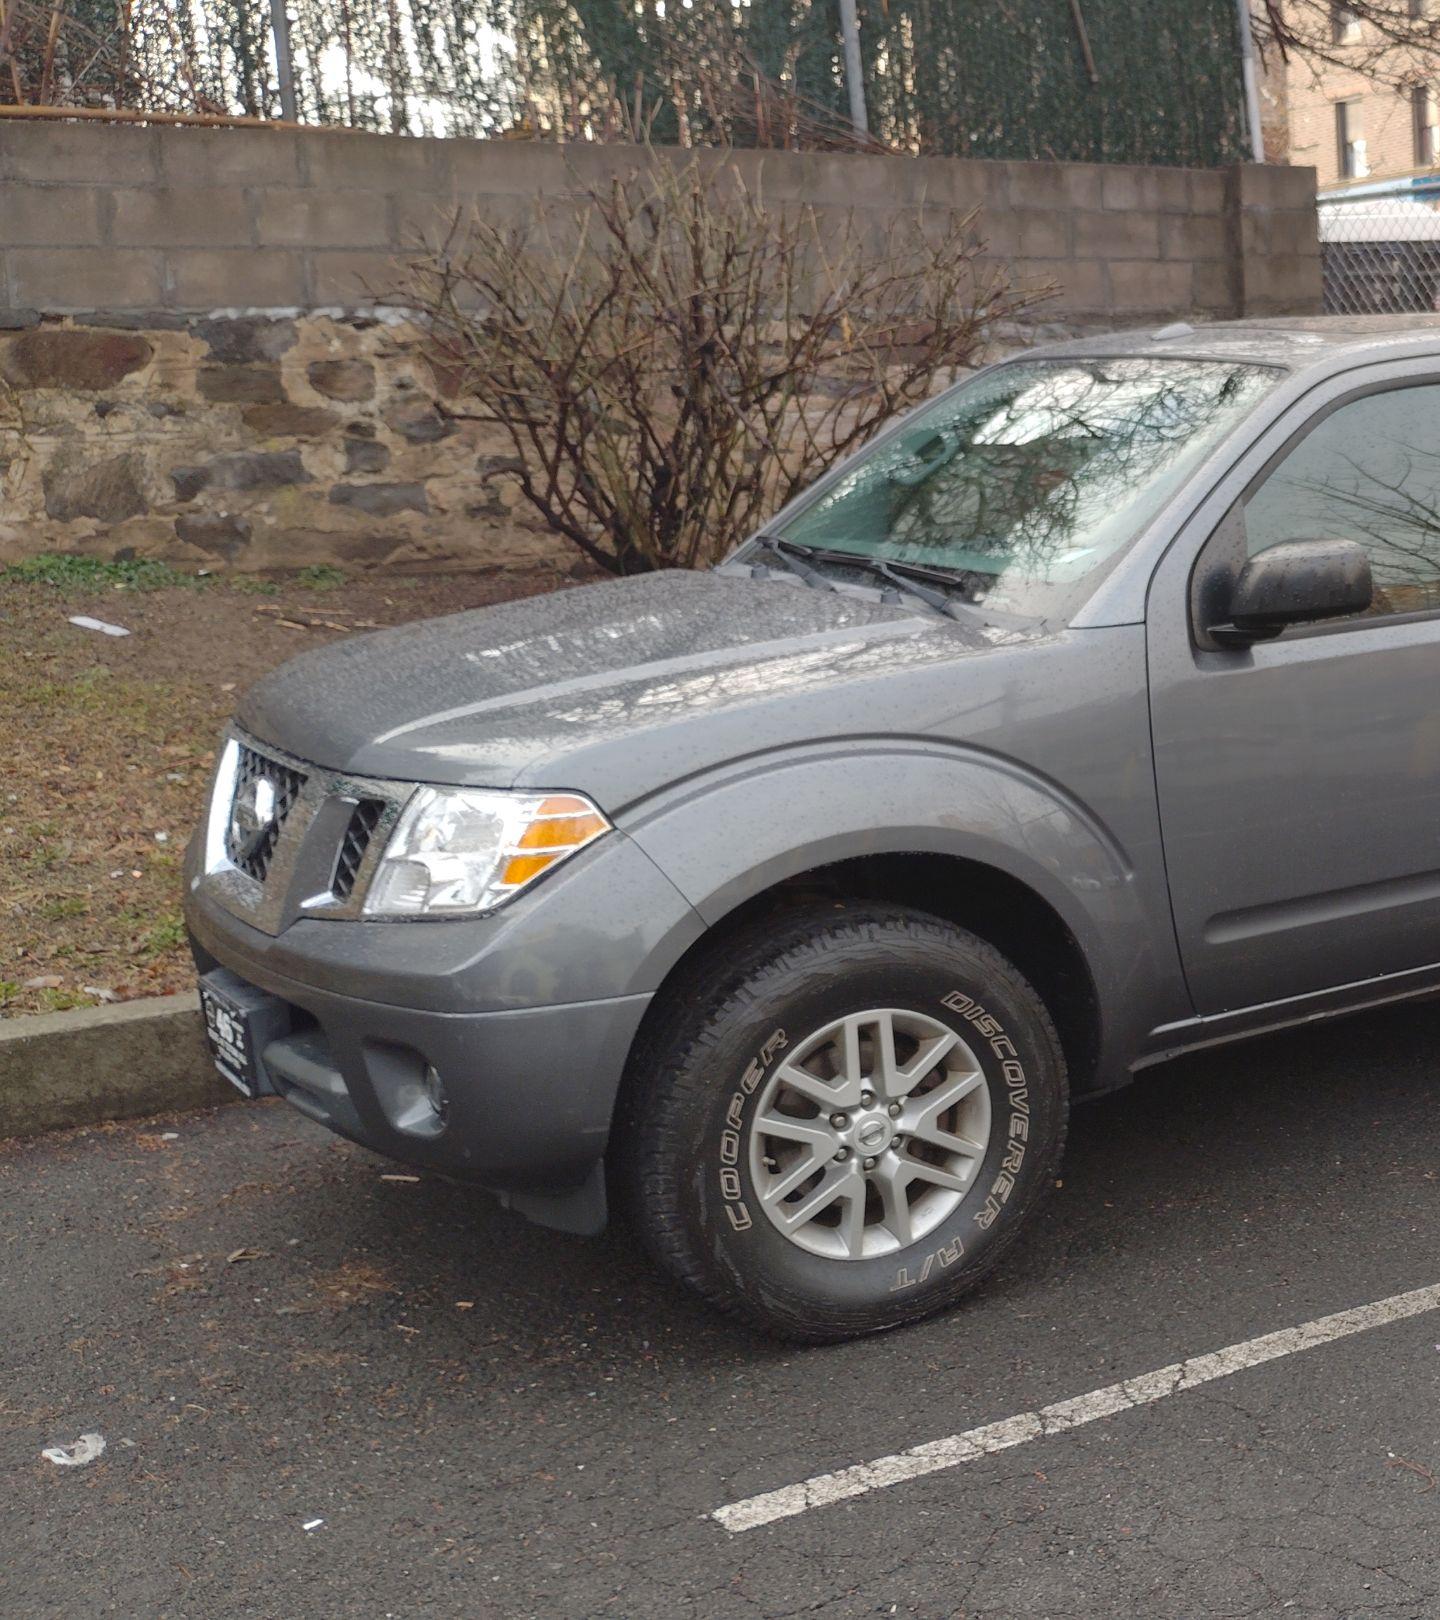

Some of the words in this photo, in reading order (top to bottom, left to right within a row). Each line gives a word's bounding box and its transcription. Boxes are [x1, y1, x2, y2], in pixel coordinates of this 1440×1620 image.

[719, 1028, 790, 1232] COOPER
[940, 990, 1029, 1231] DISCOVERER
[889, 1236, 965, 1292] A/T
